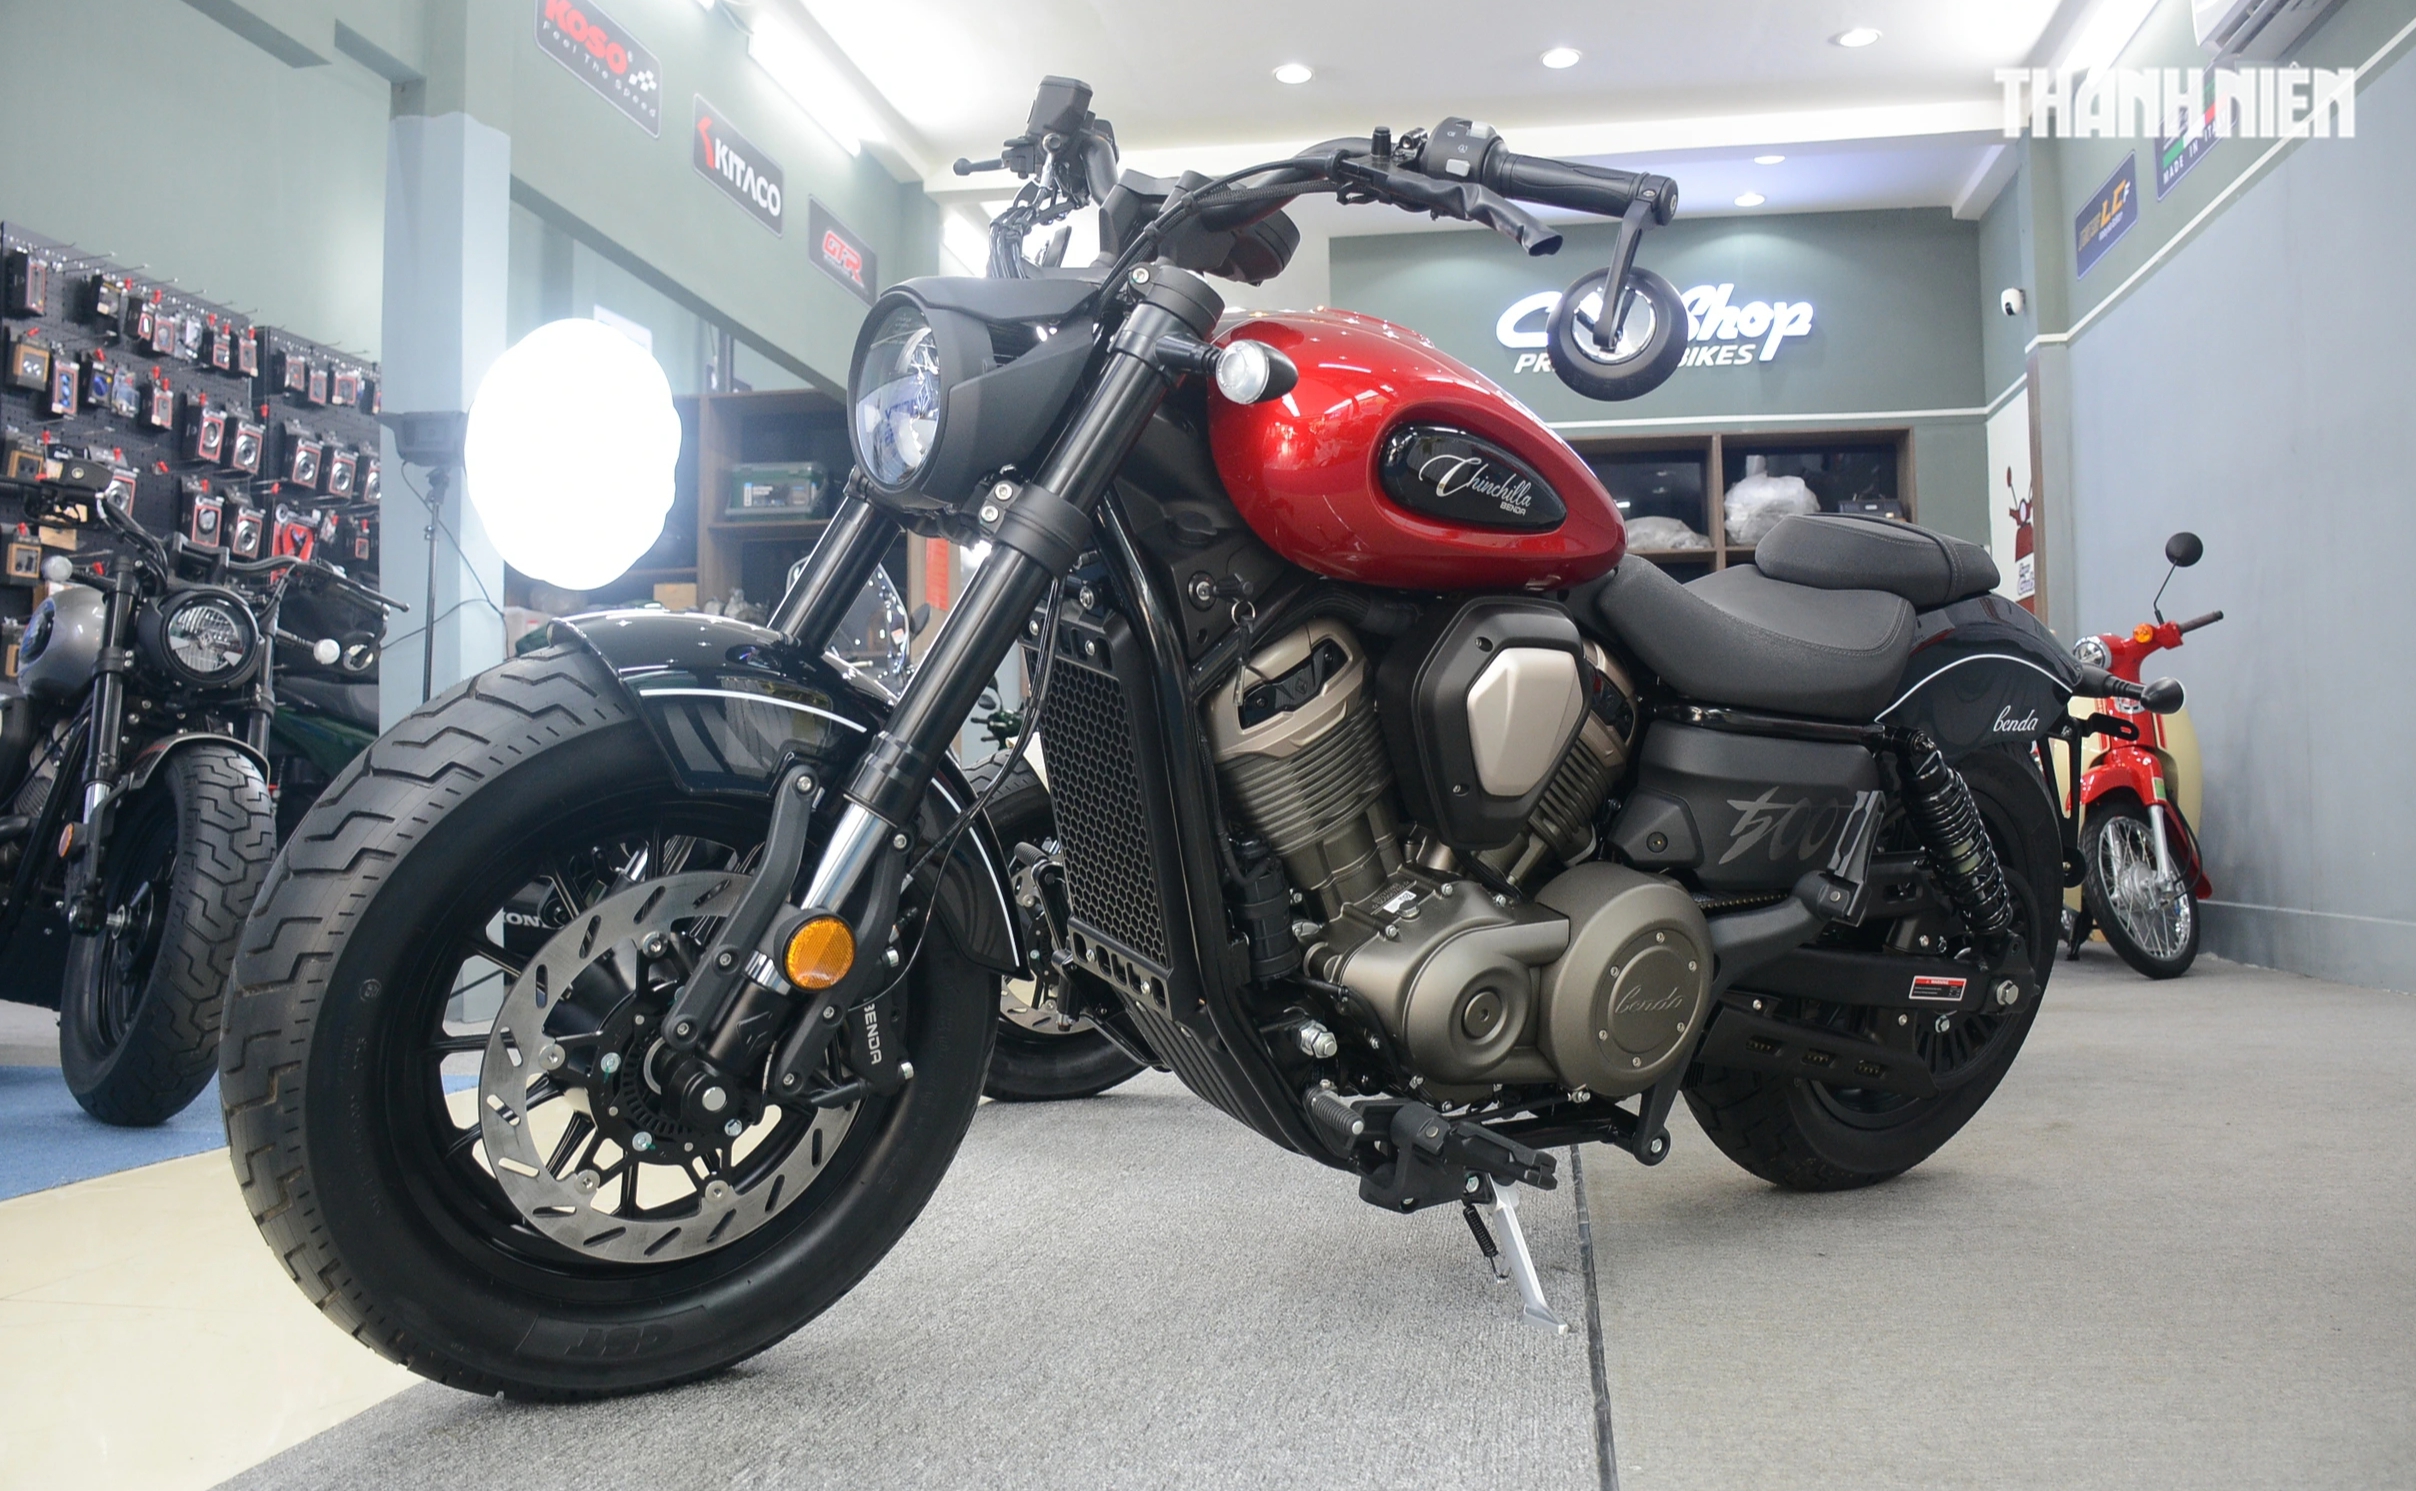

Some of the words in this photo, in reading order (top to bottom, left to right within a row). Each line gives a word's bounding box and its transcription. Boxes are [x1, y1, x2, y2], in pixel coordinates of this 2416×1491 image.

[543, 20, 577, 54] Feel
[585, 52, 609, 79] The
[615, 79, 656, 118] Speed
[545, 0, 628, 75] KOSO
[714, 137, 781, 217] KITACO
[2163, 154, 2185, 185] MADE
[2189, 139, 2199, 158] IN
[1678, 283, 1814, 362] Shop
[1419, 454, 1532, 507] Chinchilla
[1499, 501, 1527, 516] BENDA
[1993, 704, 2039, 732] benda
[863, 996, 882, 1065] BENDA
